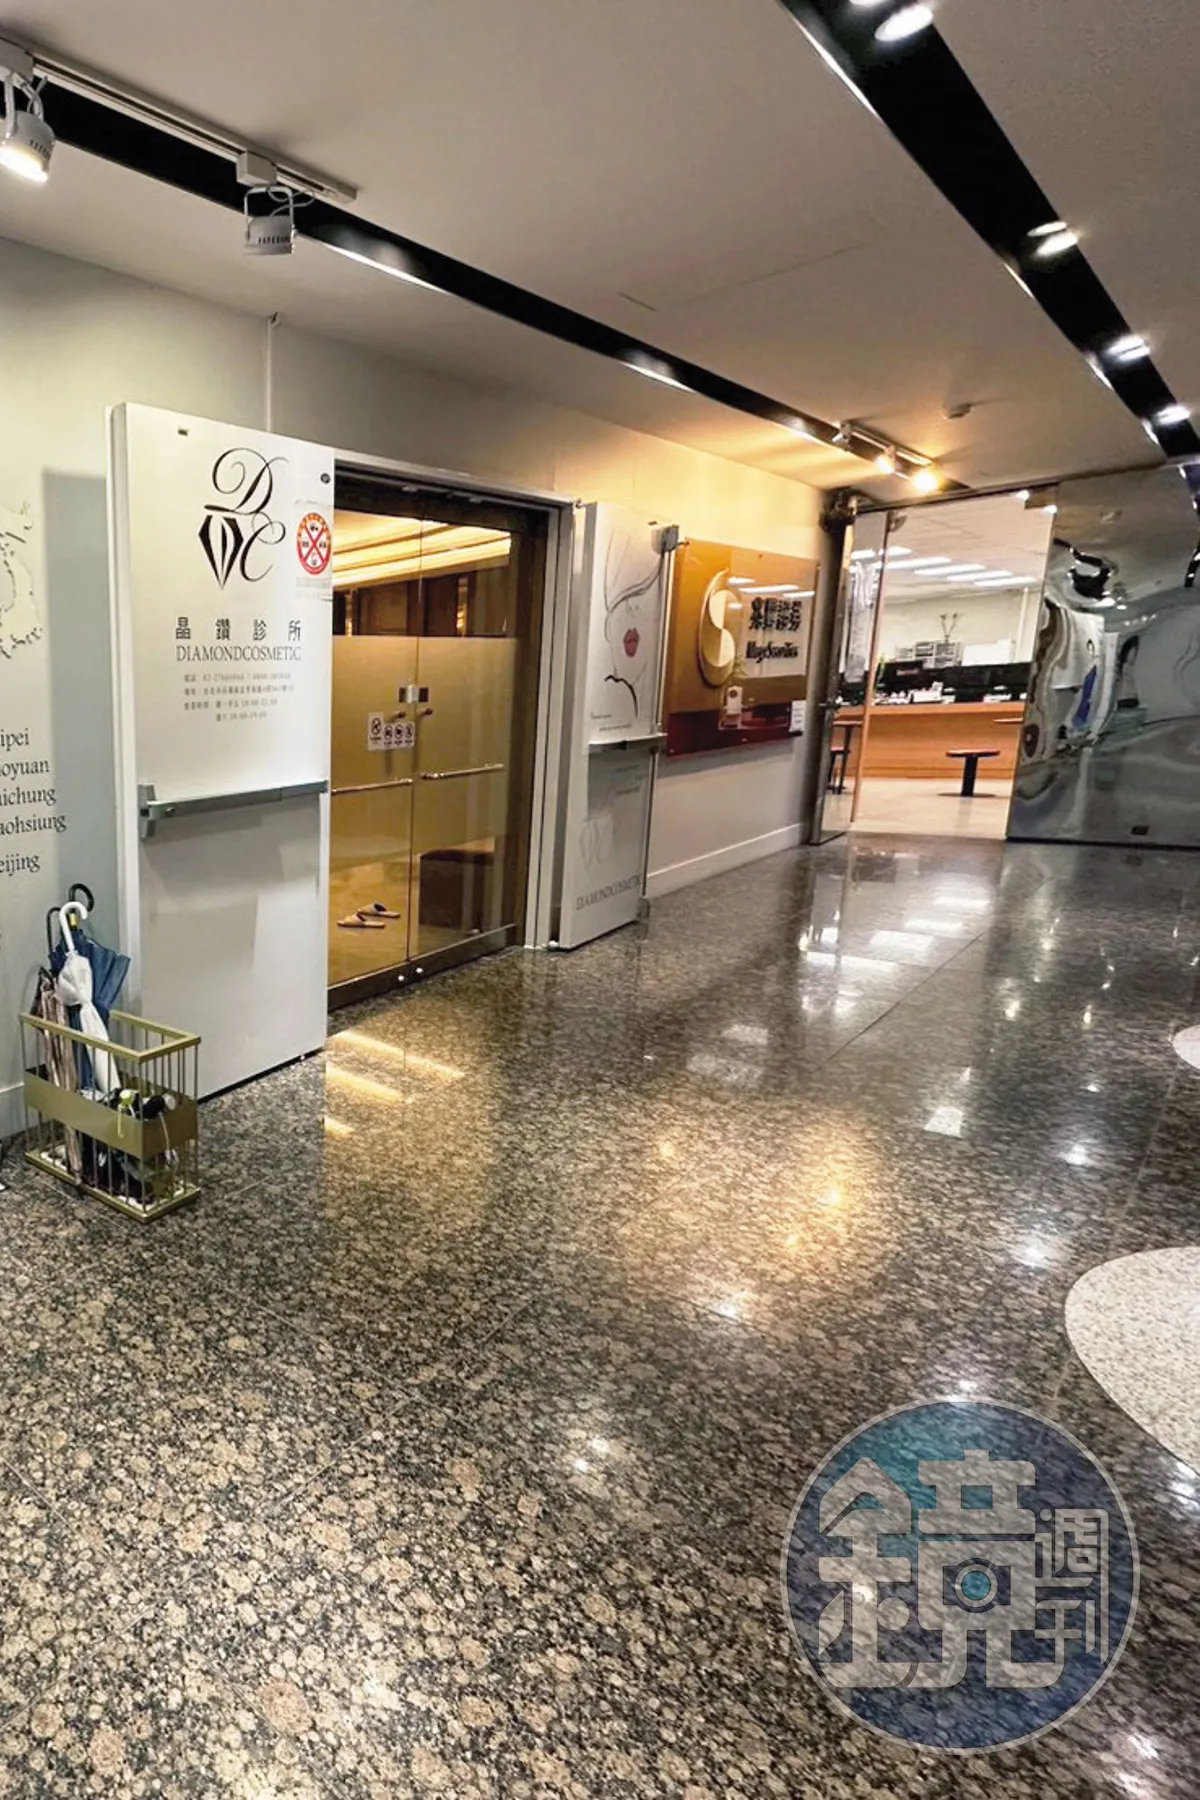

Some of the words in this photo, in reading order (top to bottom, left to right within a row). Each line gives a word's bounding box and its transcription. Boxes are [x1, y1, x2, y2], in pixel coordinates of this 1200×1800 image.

[175, 616, 301, 641] 晶鑽診所
[176, 645, 301, 662] DIAMONDCOSMETIC
